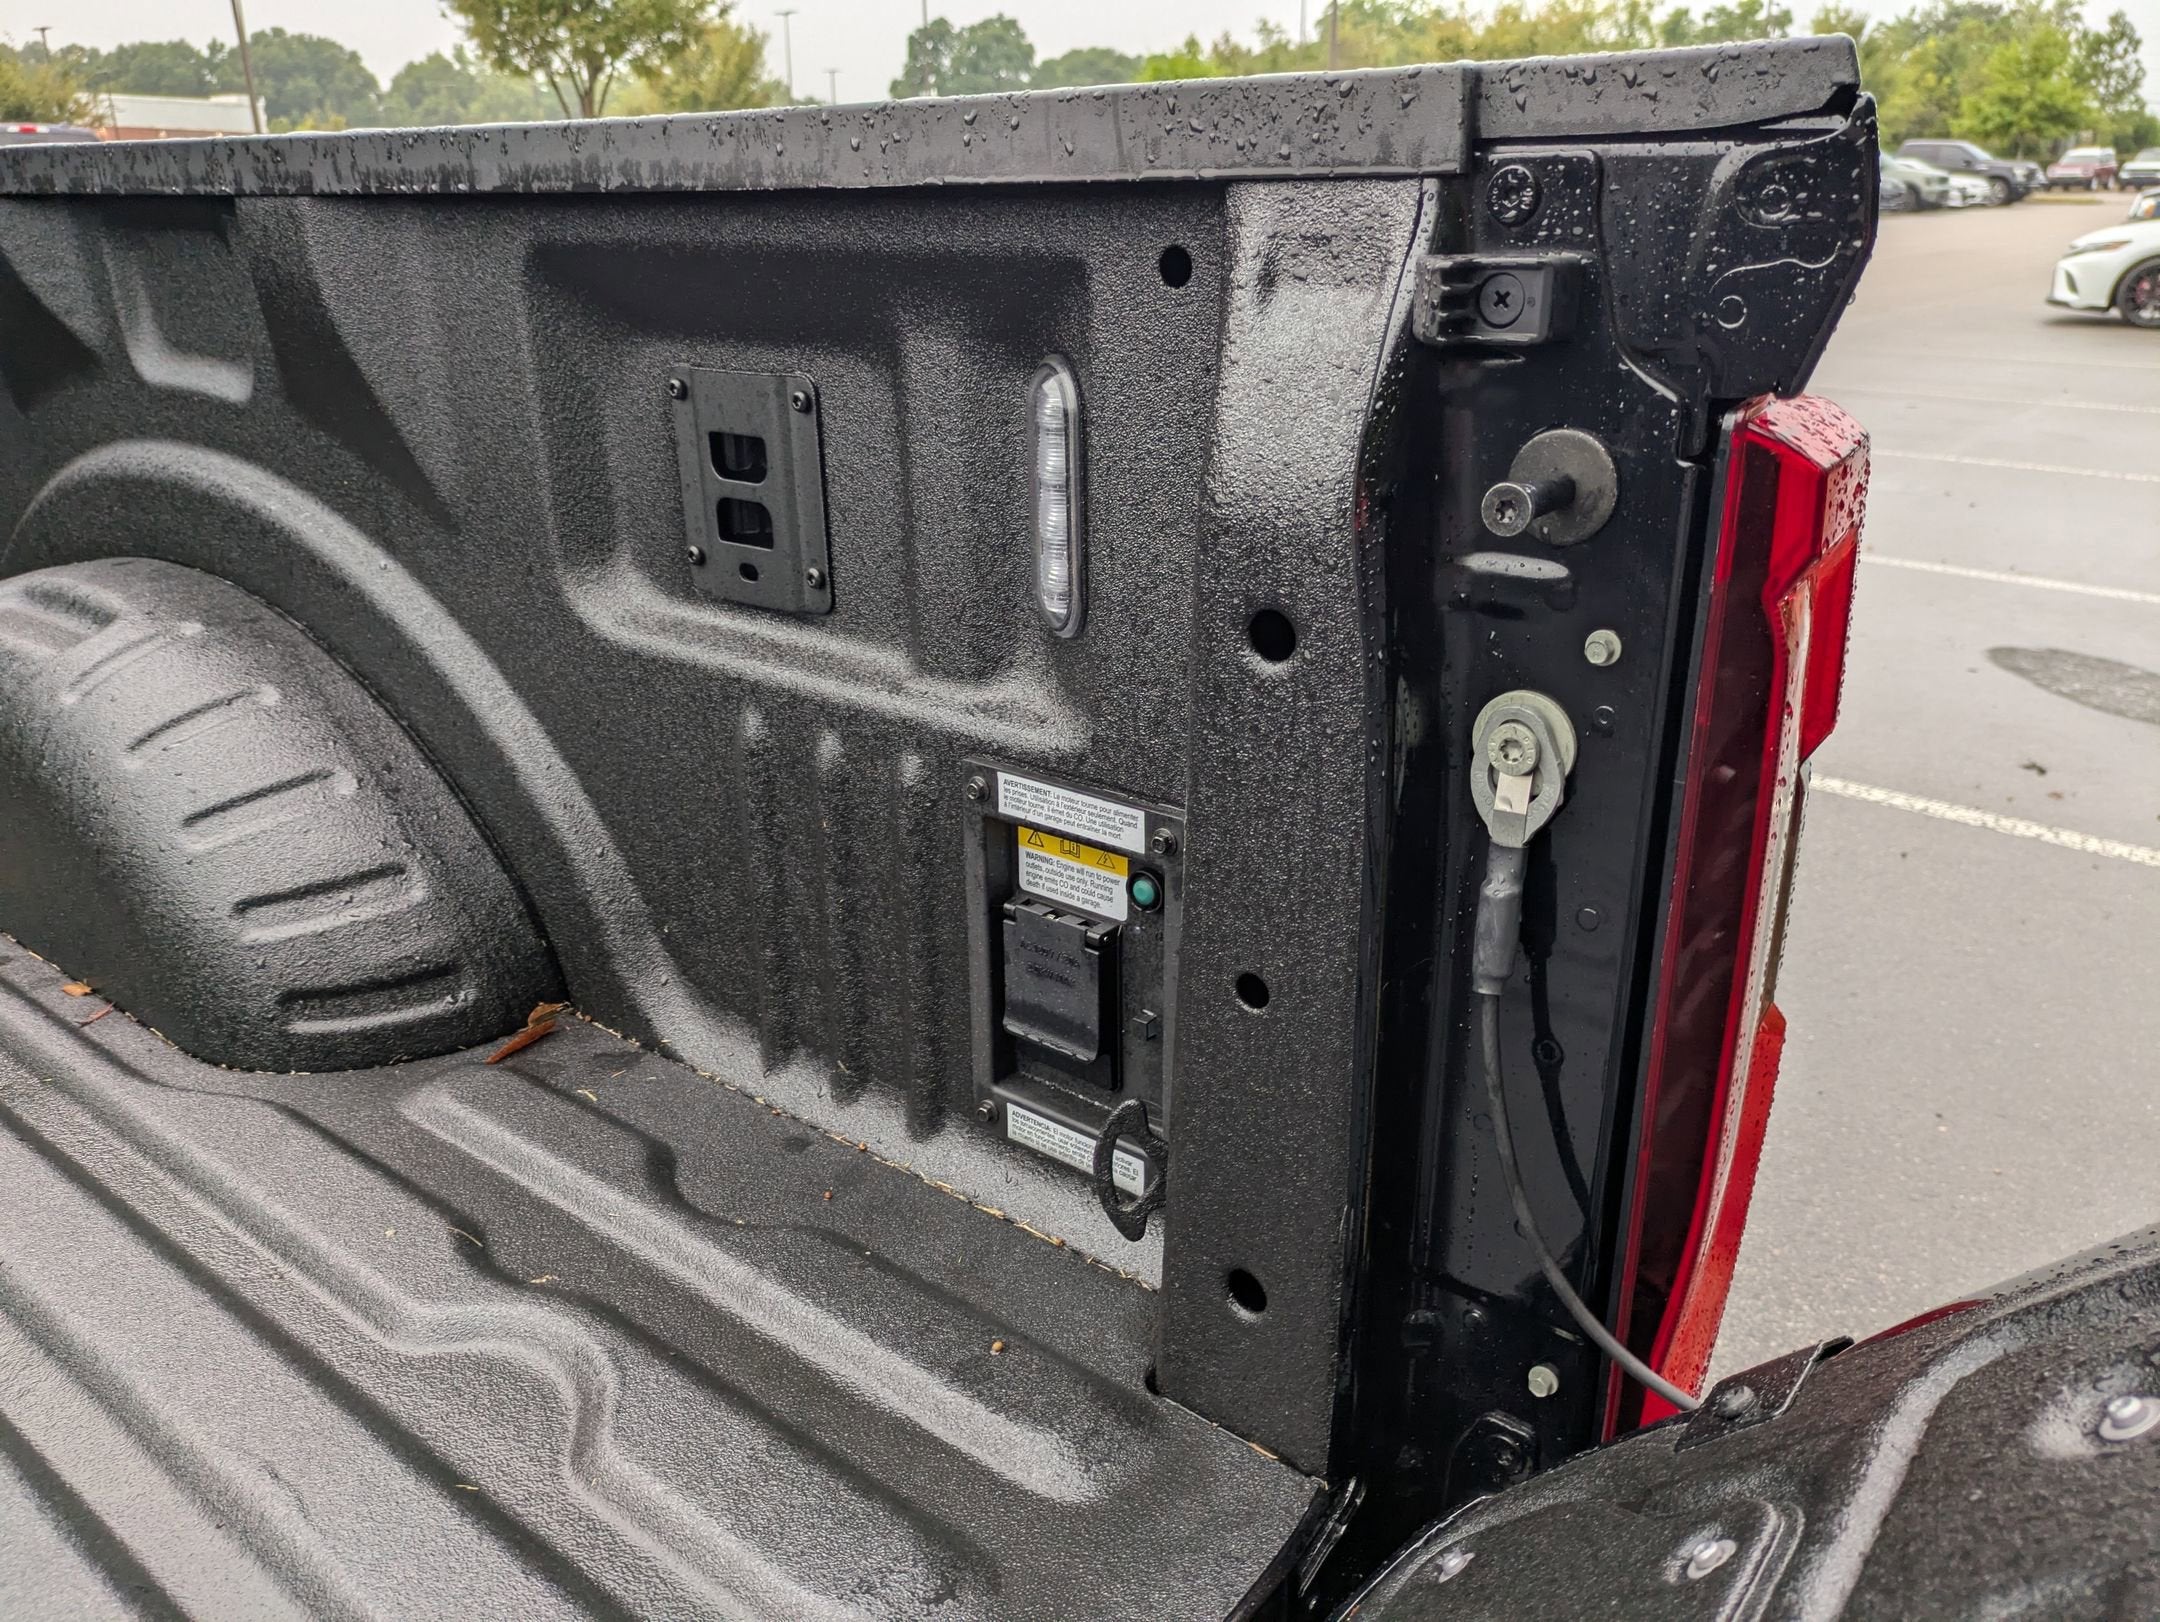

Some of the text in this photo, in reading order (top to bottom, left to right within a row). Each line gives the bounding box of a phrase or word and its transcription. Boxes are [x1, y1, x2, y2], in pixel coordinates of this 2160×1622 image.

[1003, 778, 1052, 798] AVERTISSEMENT:
[1062, 795, 1079, 805] moteur
[1081, 801, 1098, 811] tourne
[1100, 806, 1112, 815] pour
[1114, 809, 1138, 822] alimenter
[1009, 796, 1027, 806] moteur
[1074, 813, 1084, 822] CO.
[1086, 816, 1097, 825] Une
[1099, 820, 1124, 833] utilisation
[1030, 794, 1055, 806] Utilisation
[1088, 810, 1116, 823] seulement.
[1119, 818, 1137, 829] Quand
[1032, 809, 1043, 818] d'un
[1045, 813, 1063, 825] garage
[1064, 819, 1075, 828] peut
[1108, 831, 1122, 840] mort.
[1025, 851, 1055, 867] WARNING:
[1057, 860, 1074, 874] Engine
[1086, 870, 1095, 878] run
[1103, 876, 1120, 887] power
[1045, 867, 1064, 878] outside
[1066, 874, 1075, 882] use
[1077, 876, 1088, 887] only.
[1090, 880, 1113, 895] Running
[1026, 871, 1113, 903] engine emits CO and could cause
[1026, 878, 1040, 889] death
[1046, 884, 1058, 895] used
[1060, 888, 1075, 899] inside
[1082, 896, 1101, 910] garage.
[1012, 1109, 1051, 1132] ADVERTENCIA:
